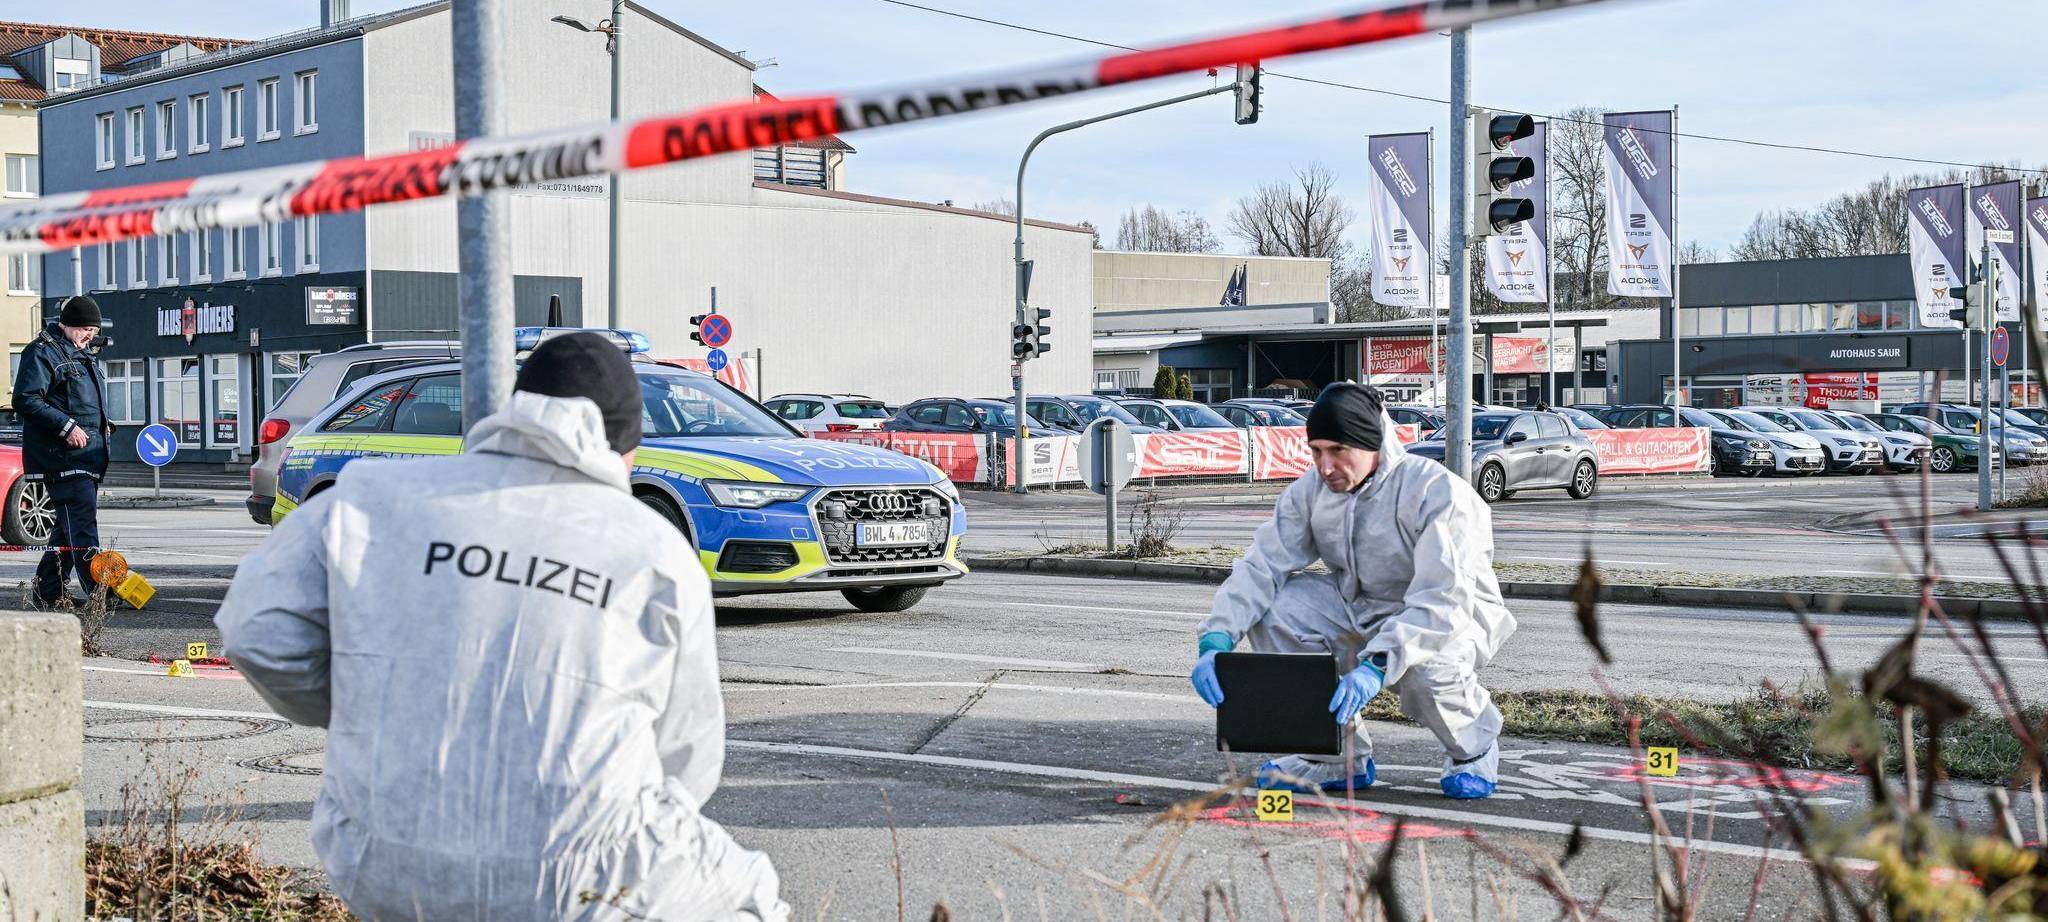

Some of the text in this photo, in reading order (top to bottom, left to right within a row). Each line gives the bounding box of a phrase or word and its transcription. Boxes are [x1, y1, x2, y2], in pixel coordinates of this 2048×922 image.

[1831, 348, 1901, 358] AUTOHAUS SAUR
[1625, 443, 1633, 455] &
[1634, 440, 1692, 455] GUTACHTEN
[793, 456, 918, 472] POLIZEI
[902, 525, 926, 541] 7854
[424, 541, 613, 609] POLIZEI
[189, 645, 205, 657] 37
[178, 663, 192, 674] 36
[1649, 751, 1672, 769] 31
[1262, 795, 1290, 814] 32
